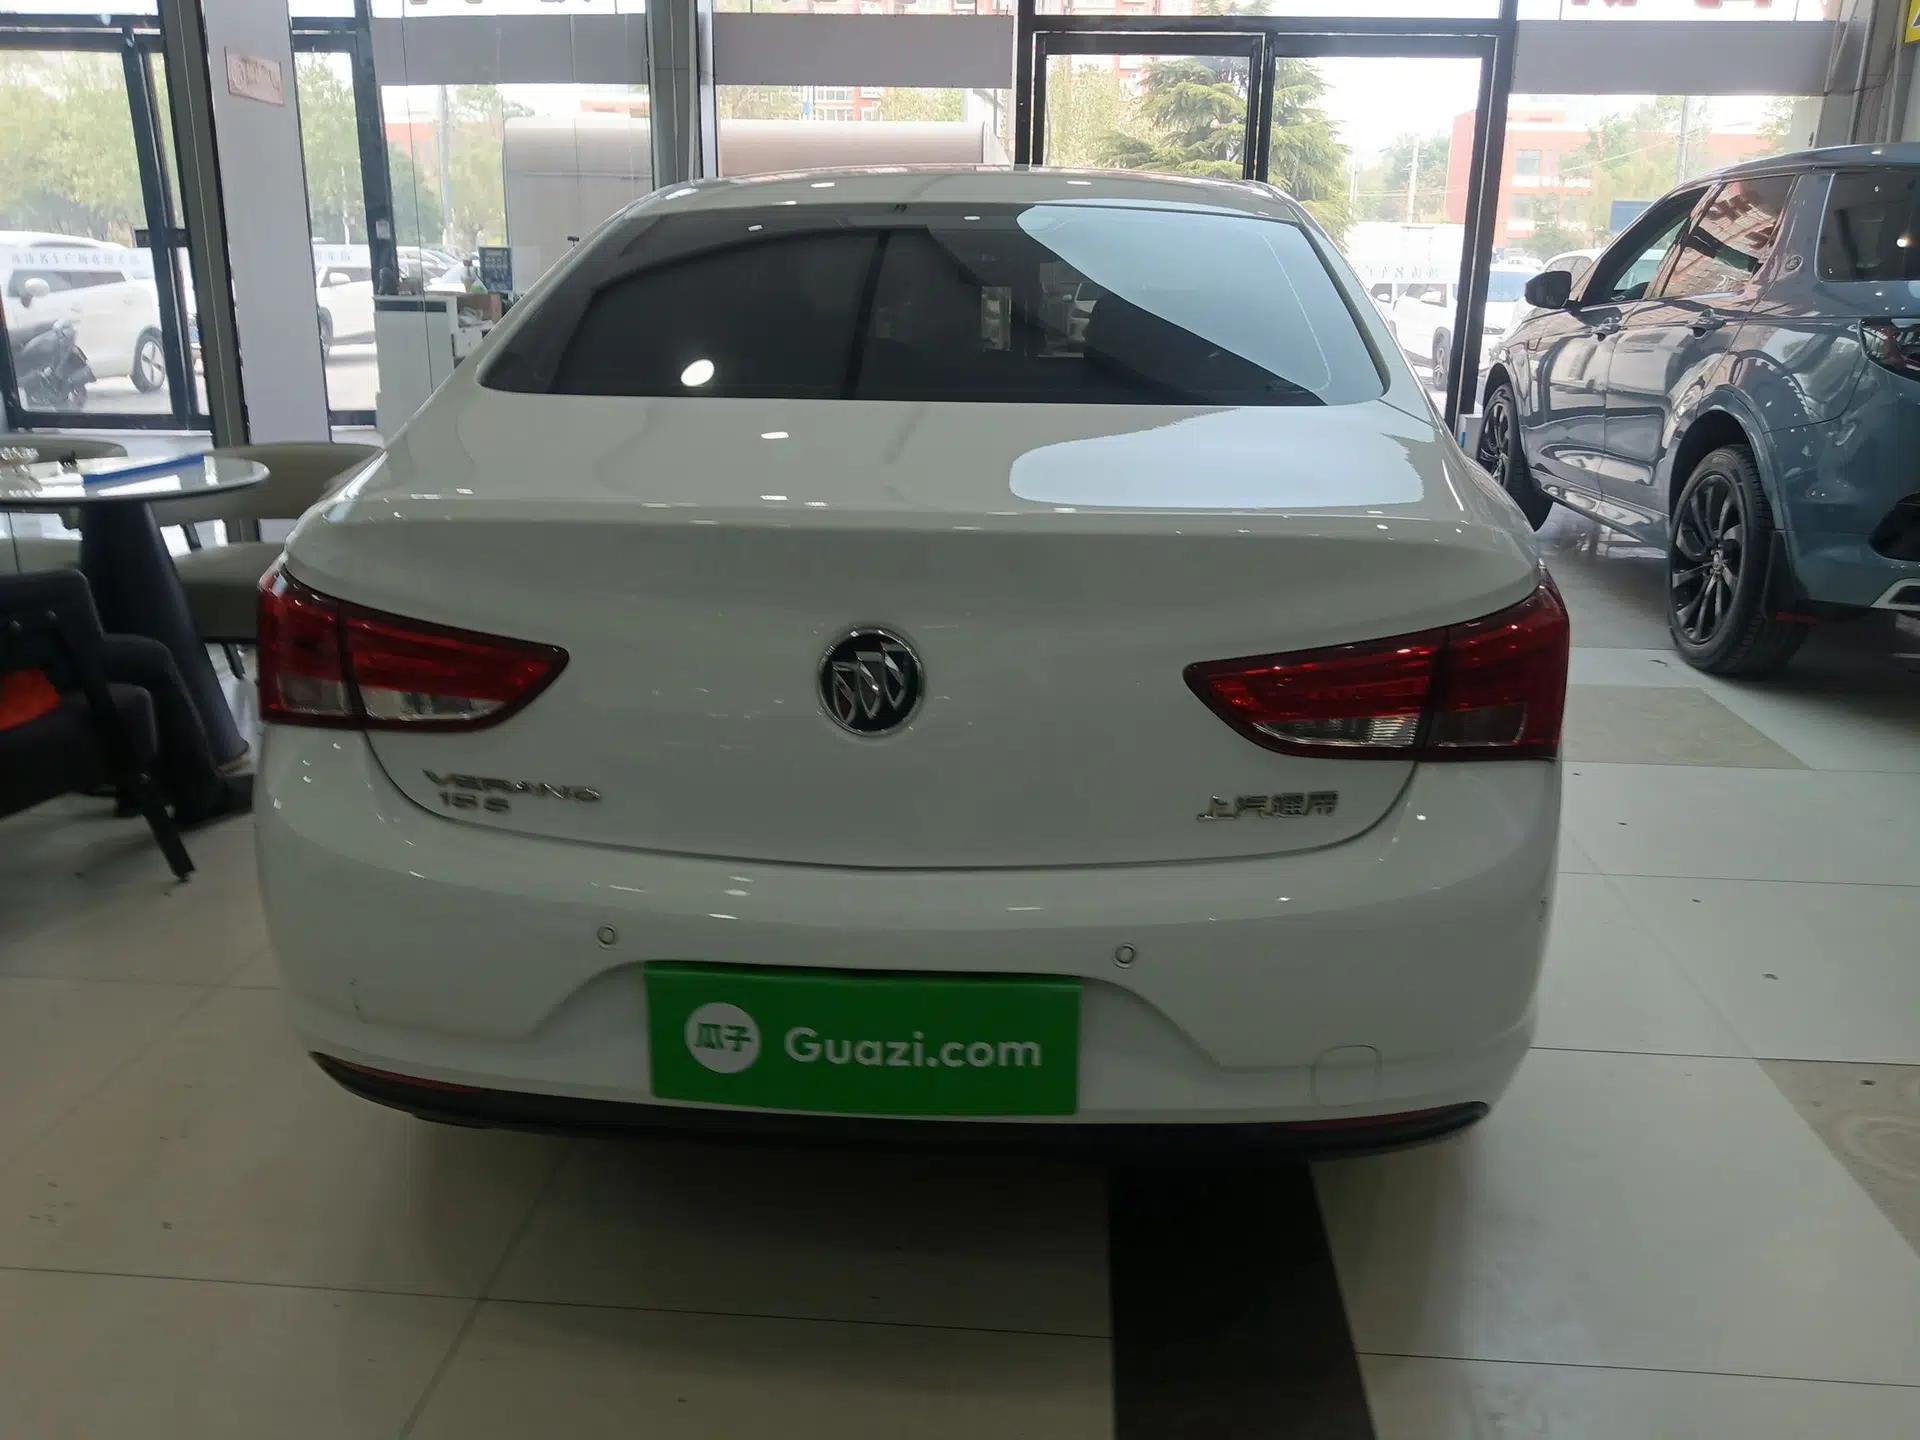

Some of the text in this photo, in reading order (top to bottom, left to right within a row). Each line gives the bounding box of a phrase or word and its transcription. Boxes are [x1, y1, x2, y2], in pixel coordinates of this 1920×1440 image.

[422, 768, 602, 801] VERANO
[1197, 790, 1340, 822] 上汽通用
[694, 1022, 753, 1053] 瓜子
[784, 1026, 1042, 1068] Guazi.com
